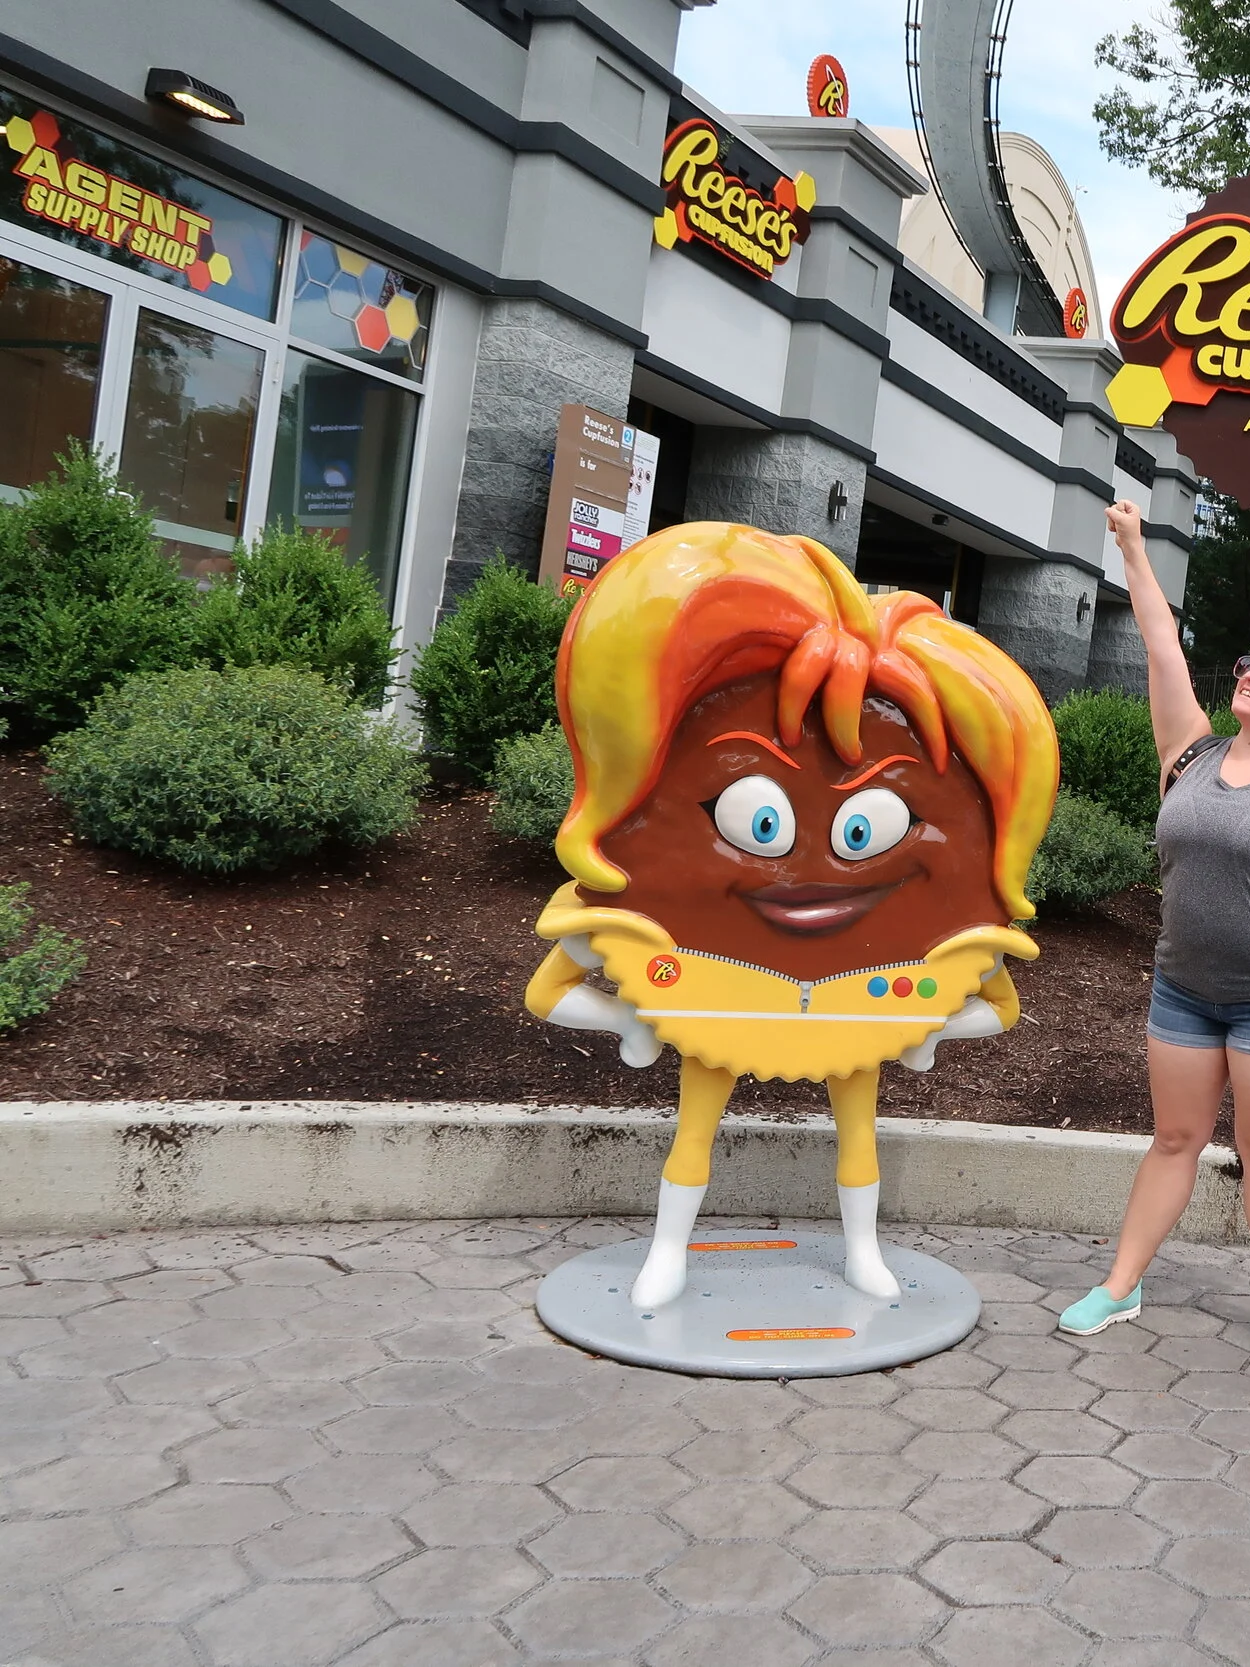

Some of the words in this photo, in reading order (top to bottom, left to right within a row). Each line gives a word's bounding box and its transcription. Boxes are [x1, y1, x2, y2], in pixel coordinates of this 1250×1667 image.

[19, 146, 211, 247] AGENT
[663, 129, 797, 258] Reese's
[27, 183, 131, 244] SUPPLY
[130, 227, 199, 269] SHOP
[584, 414, 614, 435] Reese's
[582, 426, 620, 449] Cupfusion
[579, 457, 586, 468] is
[587, 459, 597, 471] for
[573, 501, 599, 518] JOLLY
